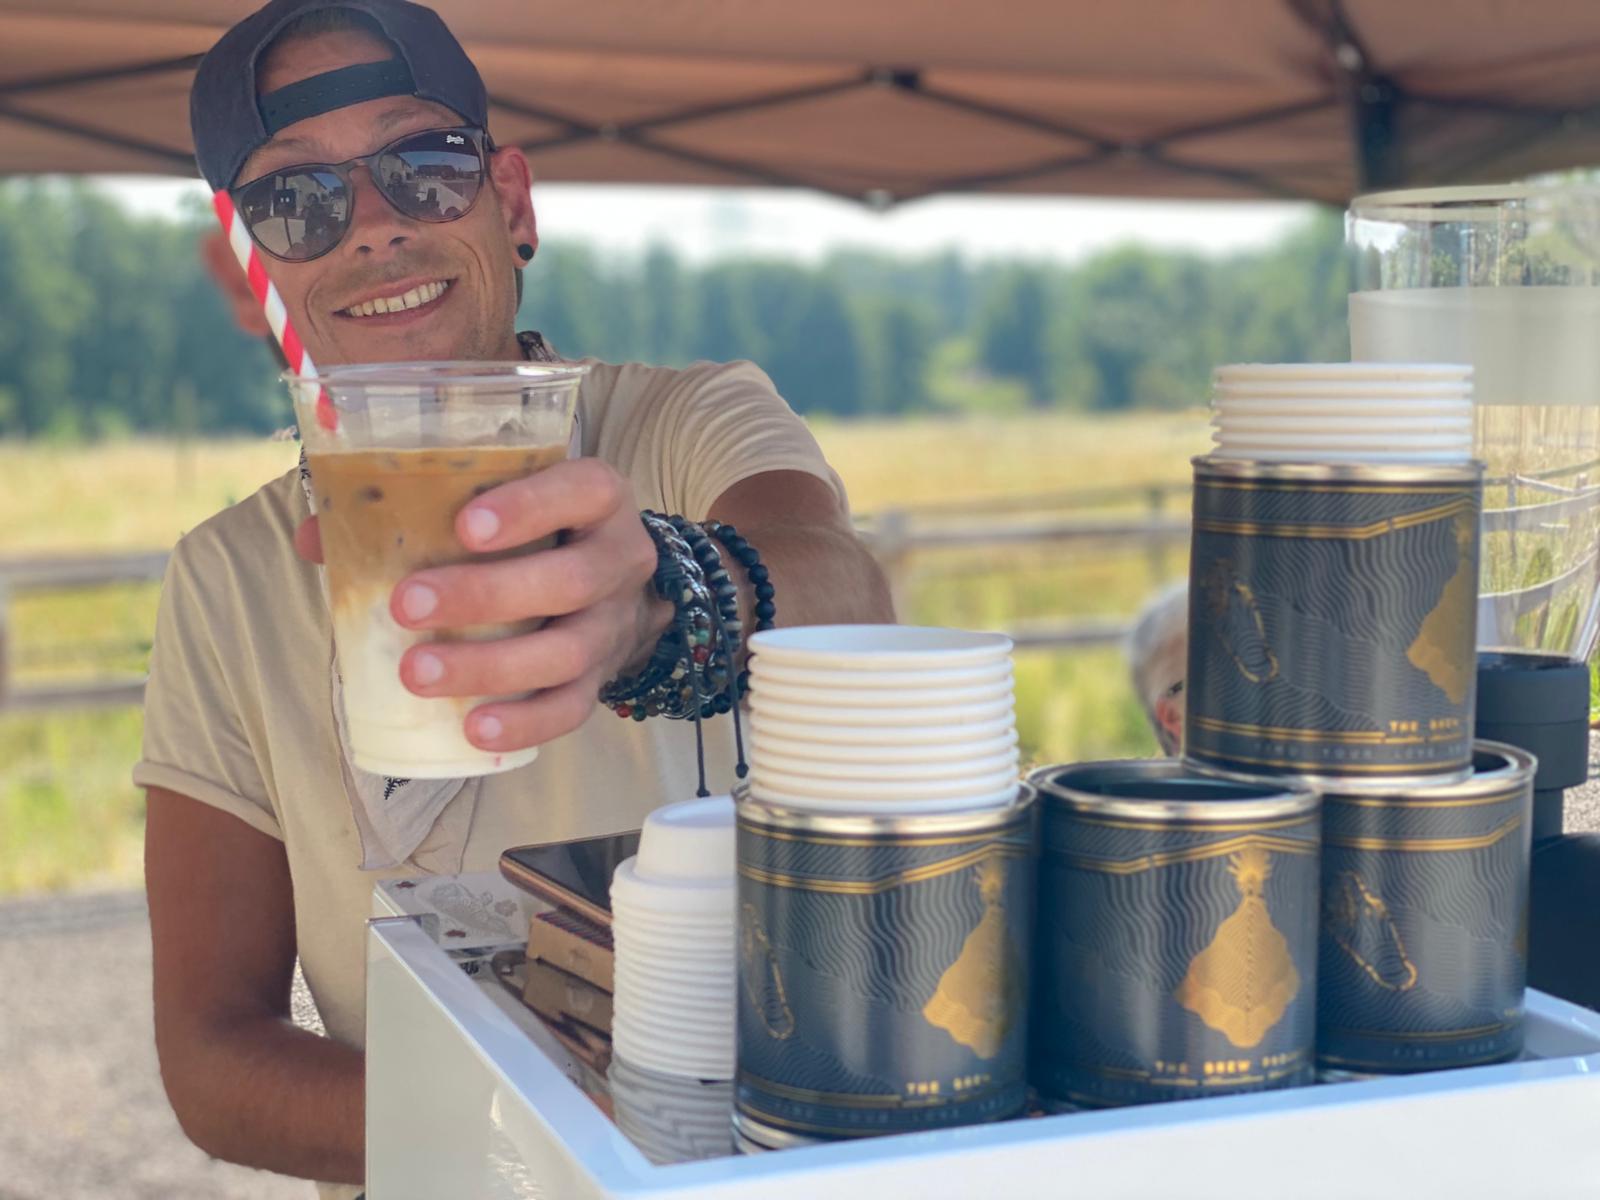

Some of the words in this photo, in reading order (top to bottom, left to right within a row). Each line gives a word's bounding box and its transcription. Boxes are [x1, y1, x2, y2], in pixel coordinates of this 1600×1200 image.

[1388, 719, 1419, 733] THE
[1154, 1059, 1189, 1076] THE
[1202, 1059, 1251, 1076] BREW
[906, 1079, 941, 1096] THE
